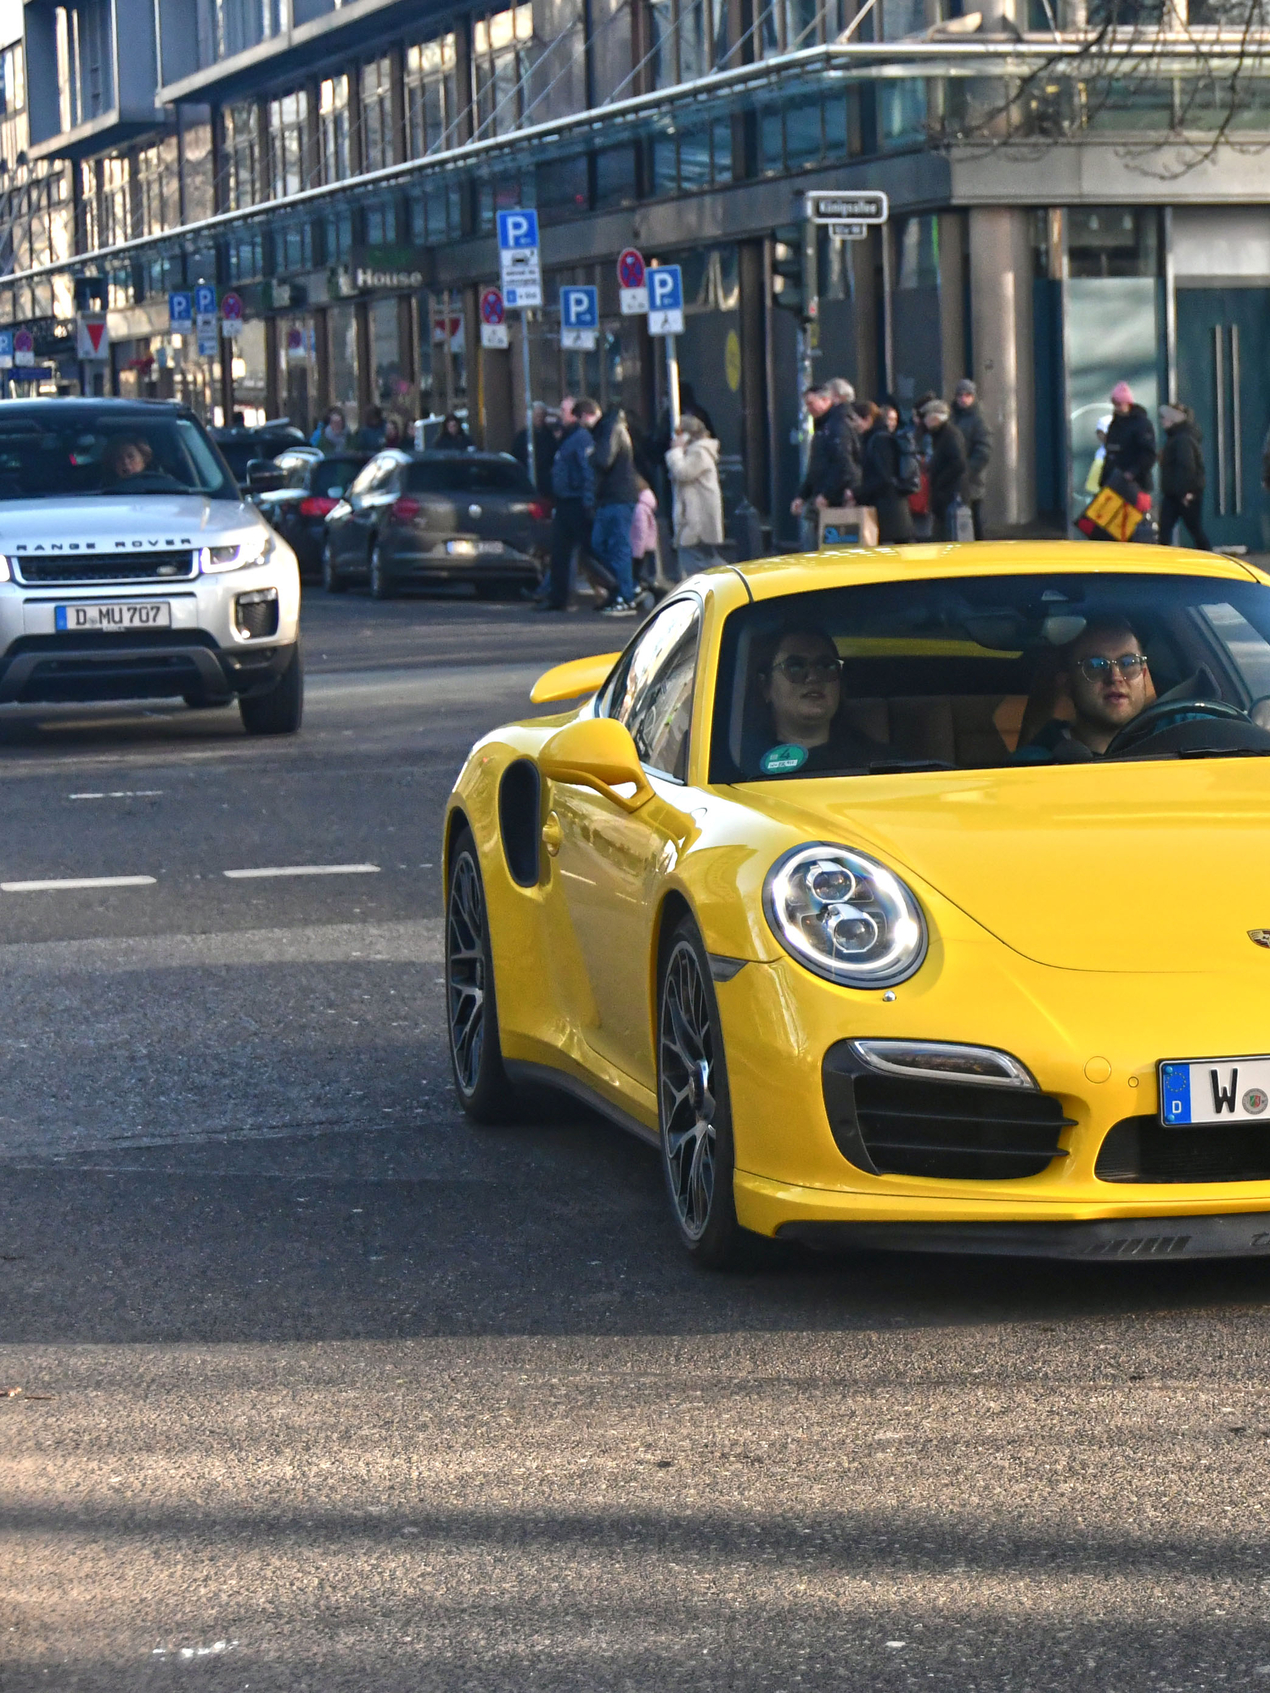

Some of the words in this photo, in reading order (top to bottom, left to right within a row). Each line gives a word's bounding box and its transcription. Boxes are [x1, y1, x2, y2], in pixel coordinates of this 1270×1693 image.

[506, 215, 529, 247] P
[357, 268, 423, 288] House
[654, 272, 674, 307] P
[569, 291, 590, 324] P
[16, 542, 96, 552] RANGE
[115, 538, 192, 549] ROVER
[75, 608, 87, 626] D
[100, 607, 123, 625] MU
[127, 606, 161, 624] 707
[1210, 1067, 1239, 1114] W
[1172, 1100, 1182, 1114] D
